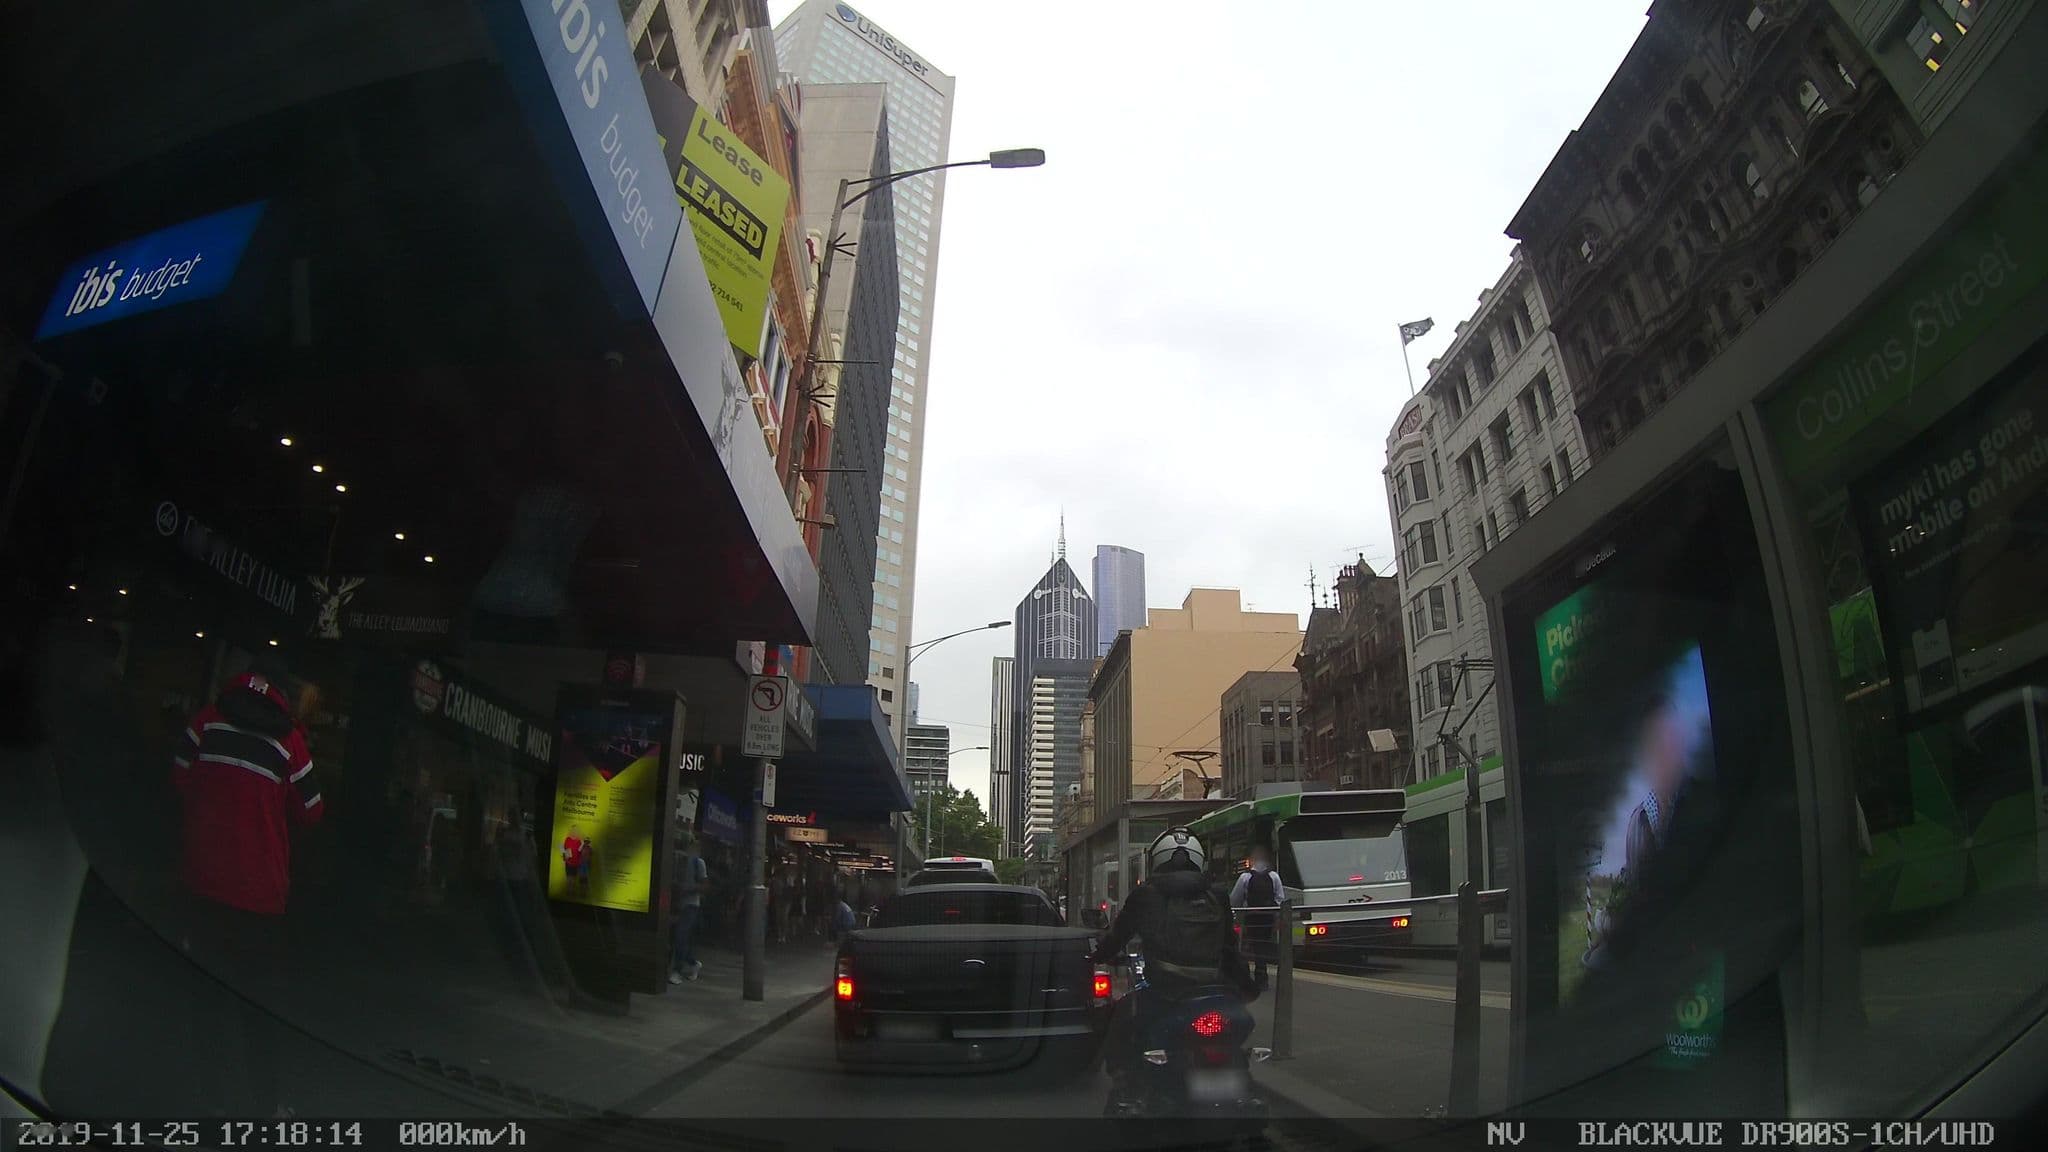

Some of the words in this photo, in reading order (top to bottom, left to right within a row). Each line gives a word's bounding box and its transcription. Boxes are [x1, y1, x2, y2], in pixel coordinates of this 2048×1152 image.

[857, 16, 928, 76] UniSuper
[551, 0, 608, 109] bis
[601, 113, 653, 249] budget
[697, 118, 763, 187] Lease
[676, 163, 764, 249] LEASED
[65, 260, 124, 317] ibis
[120, 252, 202, 301] budget
[1797, 338, 1907, 440] Collins
[1909, 232, 2018, 347] Street
[1880, 467, 1934, 525] myki
[1933, 448, 1977, 490] has
[1979, 408, 2033, 468] gone
[1888, 498, 1964, 560] mobile
[1967, 478, 1997, 510] on
[443, 682, 523, 750] CRANBOURNE
[1384, 870, 1407, 881] 2013
